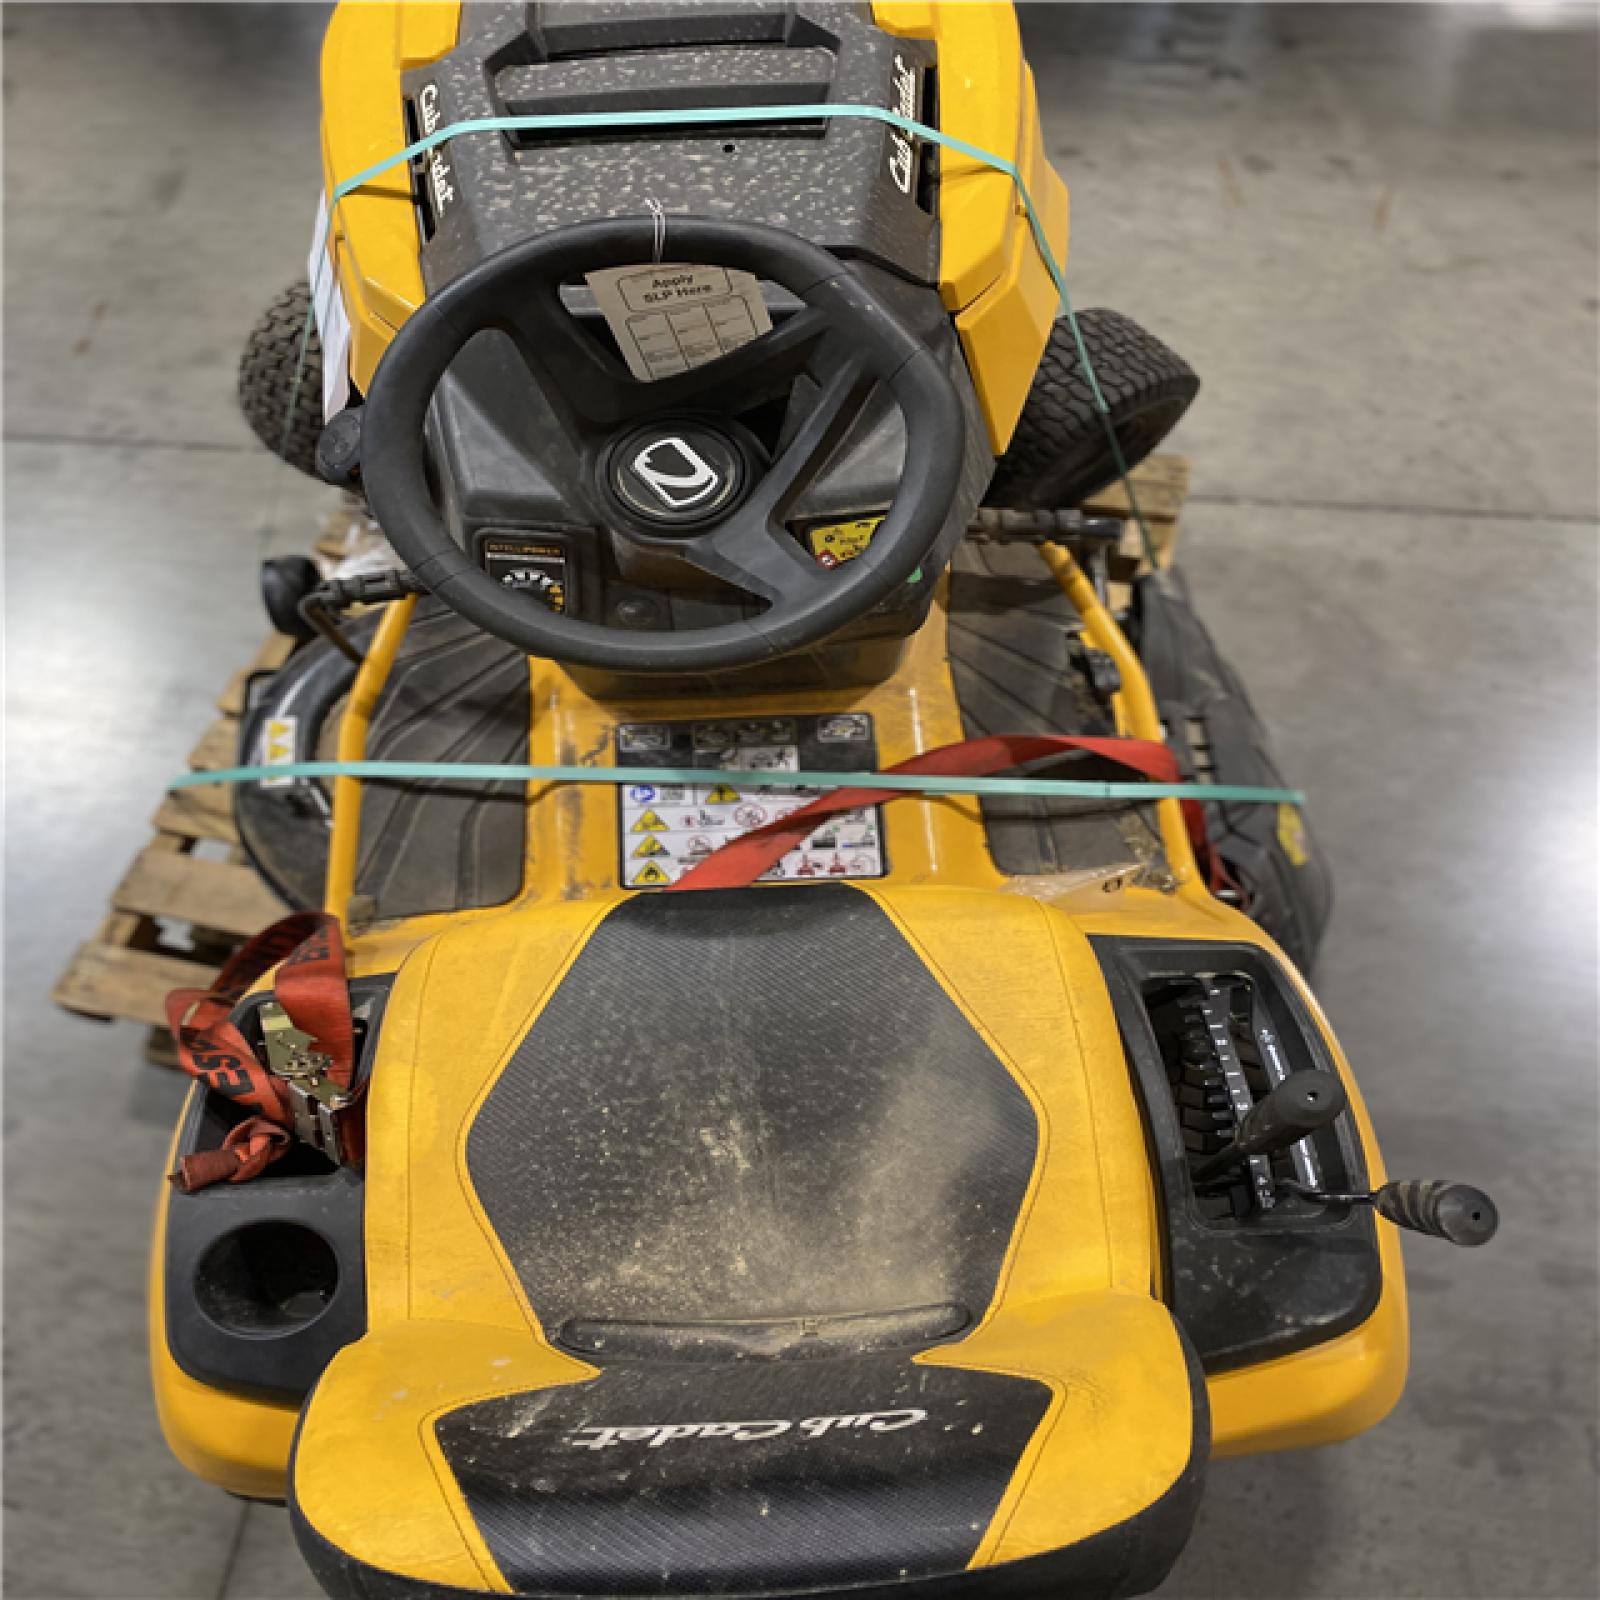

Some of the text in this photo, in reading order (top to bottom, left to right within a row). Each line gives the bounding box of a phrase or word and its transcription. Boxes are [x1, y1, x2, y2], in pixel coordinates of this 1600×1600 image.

[652, 274, 694, 289] Apply
[676, 284, 713, 298] Here
[570, 1409, 928, 1450] Cub Cadet
